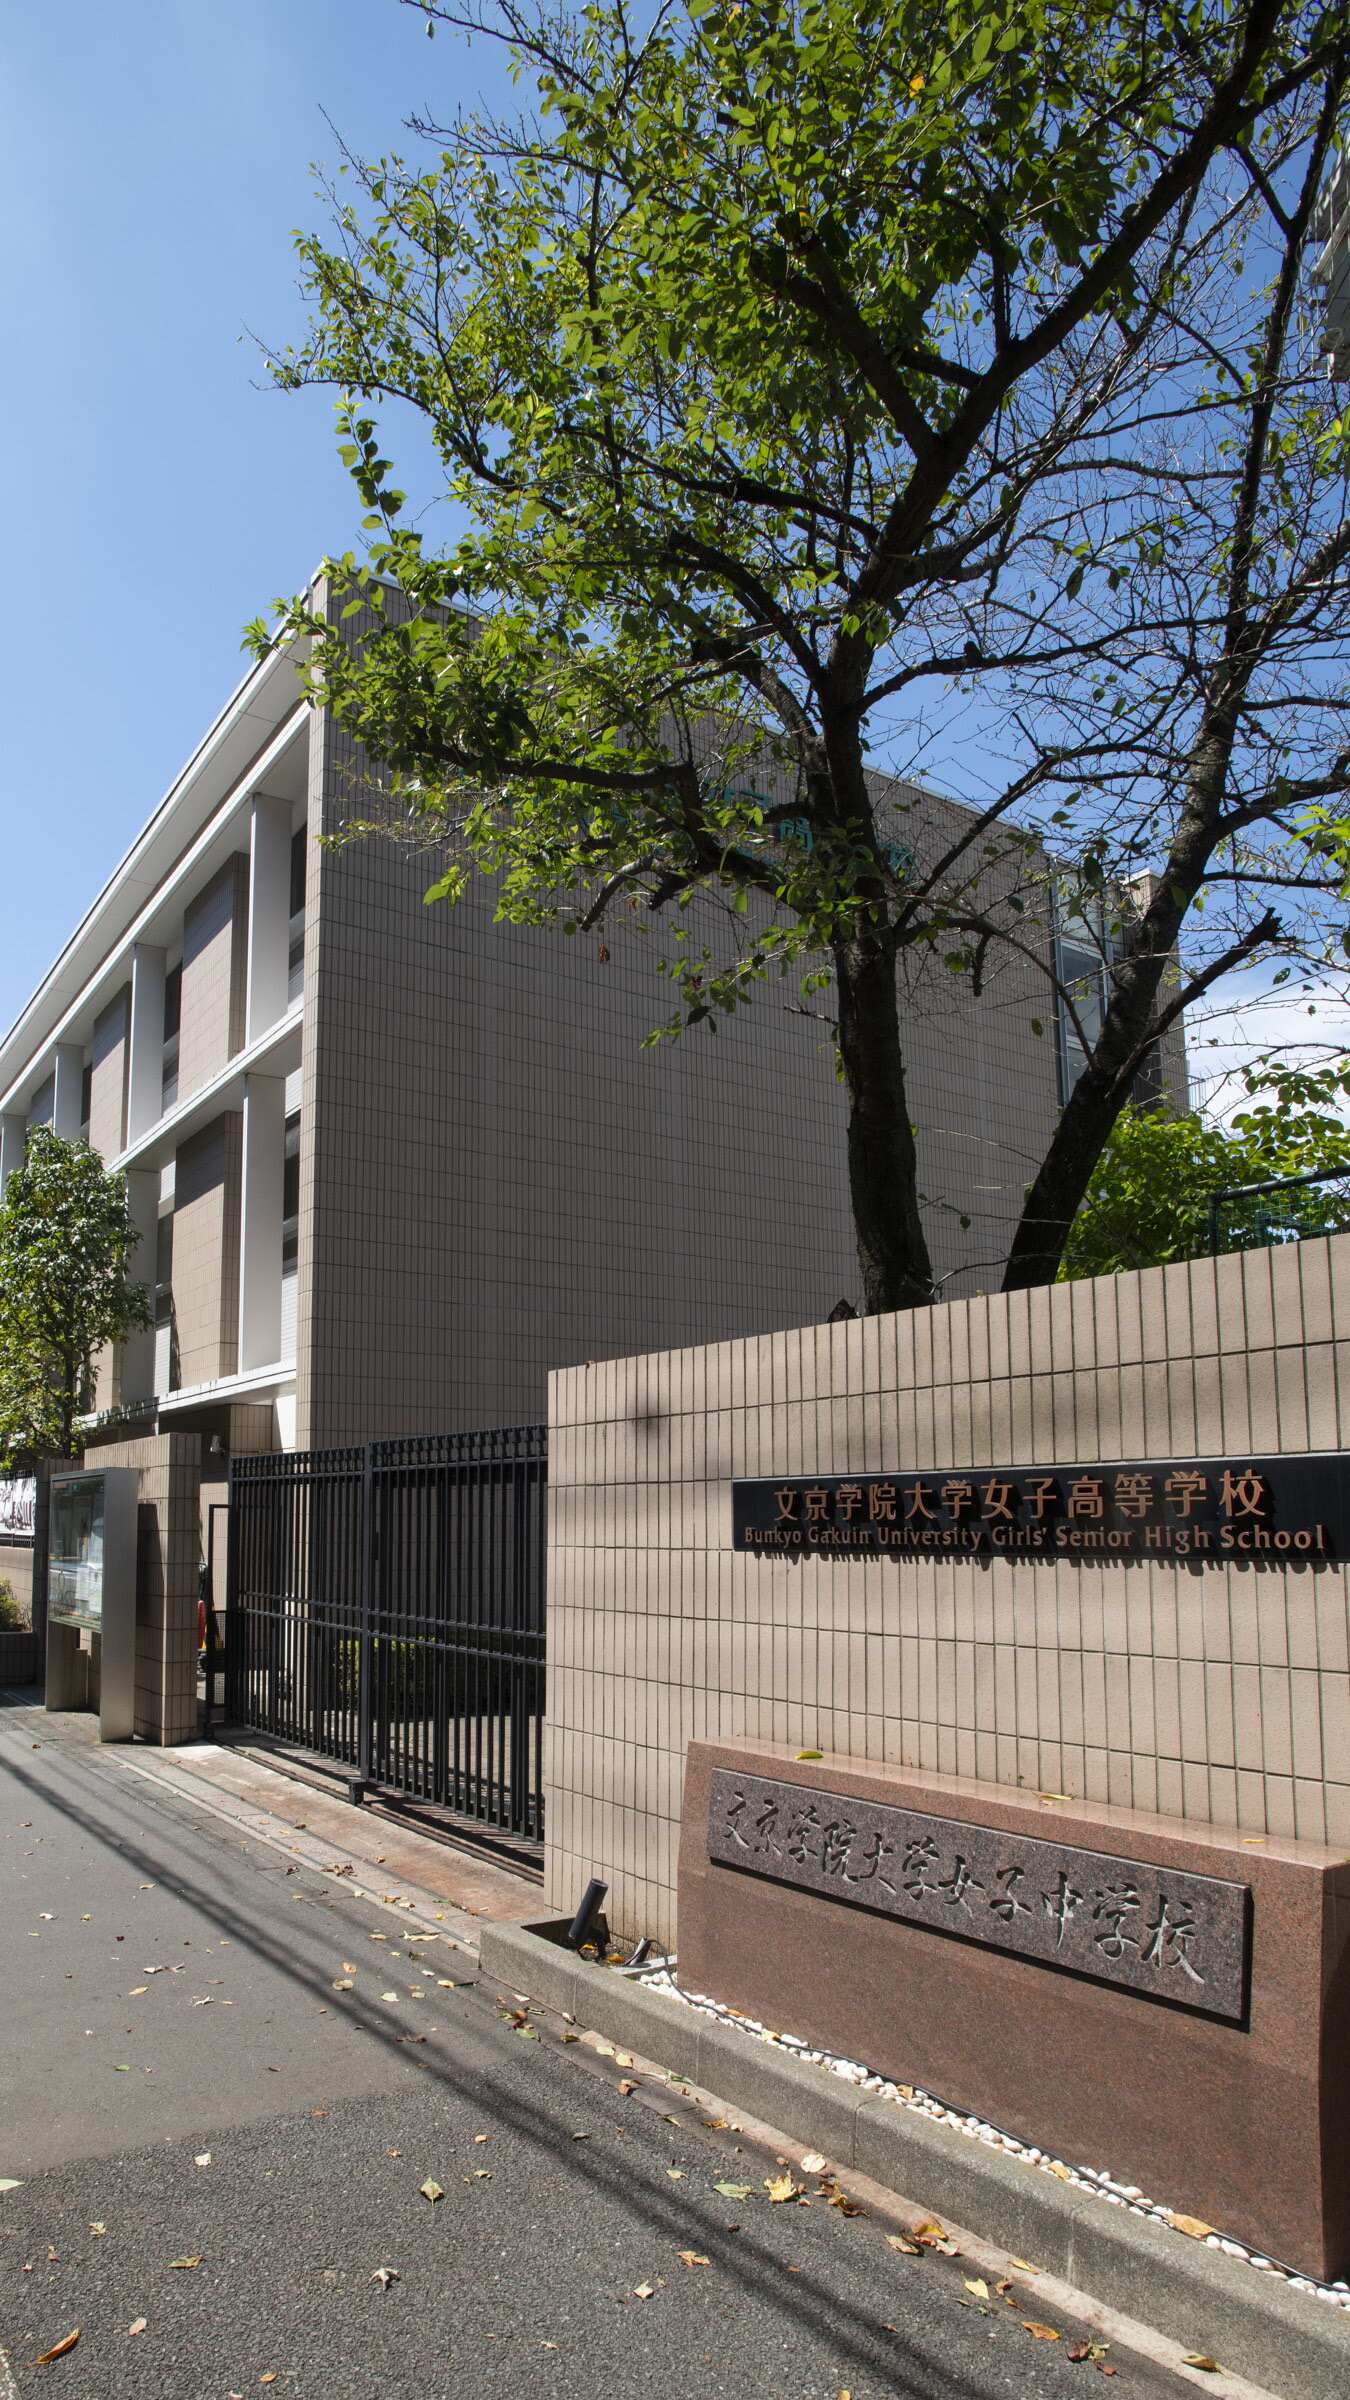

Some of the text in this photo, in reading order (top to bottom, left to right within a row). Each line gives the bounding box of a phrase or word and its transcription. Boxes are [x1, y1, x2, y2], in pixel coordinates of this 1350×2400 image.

[773, 1468, 1267, 1521] 文京学院大学女子高等学校
[744, 1523, 1326, 1553] Bunkyo Gakuin University Girls' Senior High School
[722, 1791, 1205, 1985] 文京学院大学女子中学校
